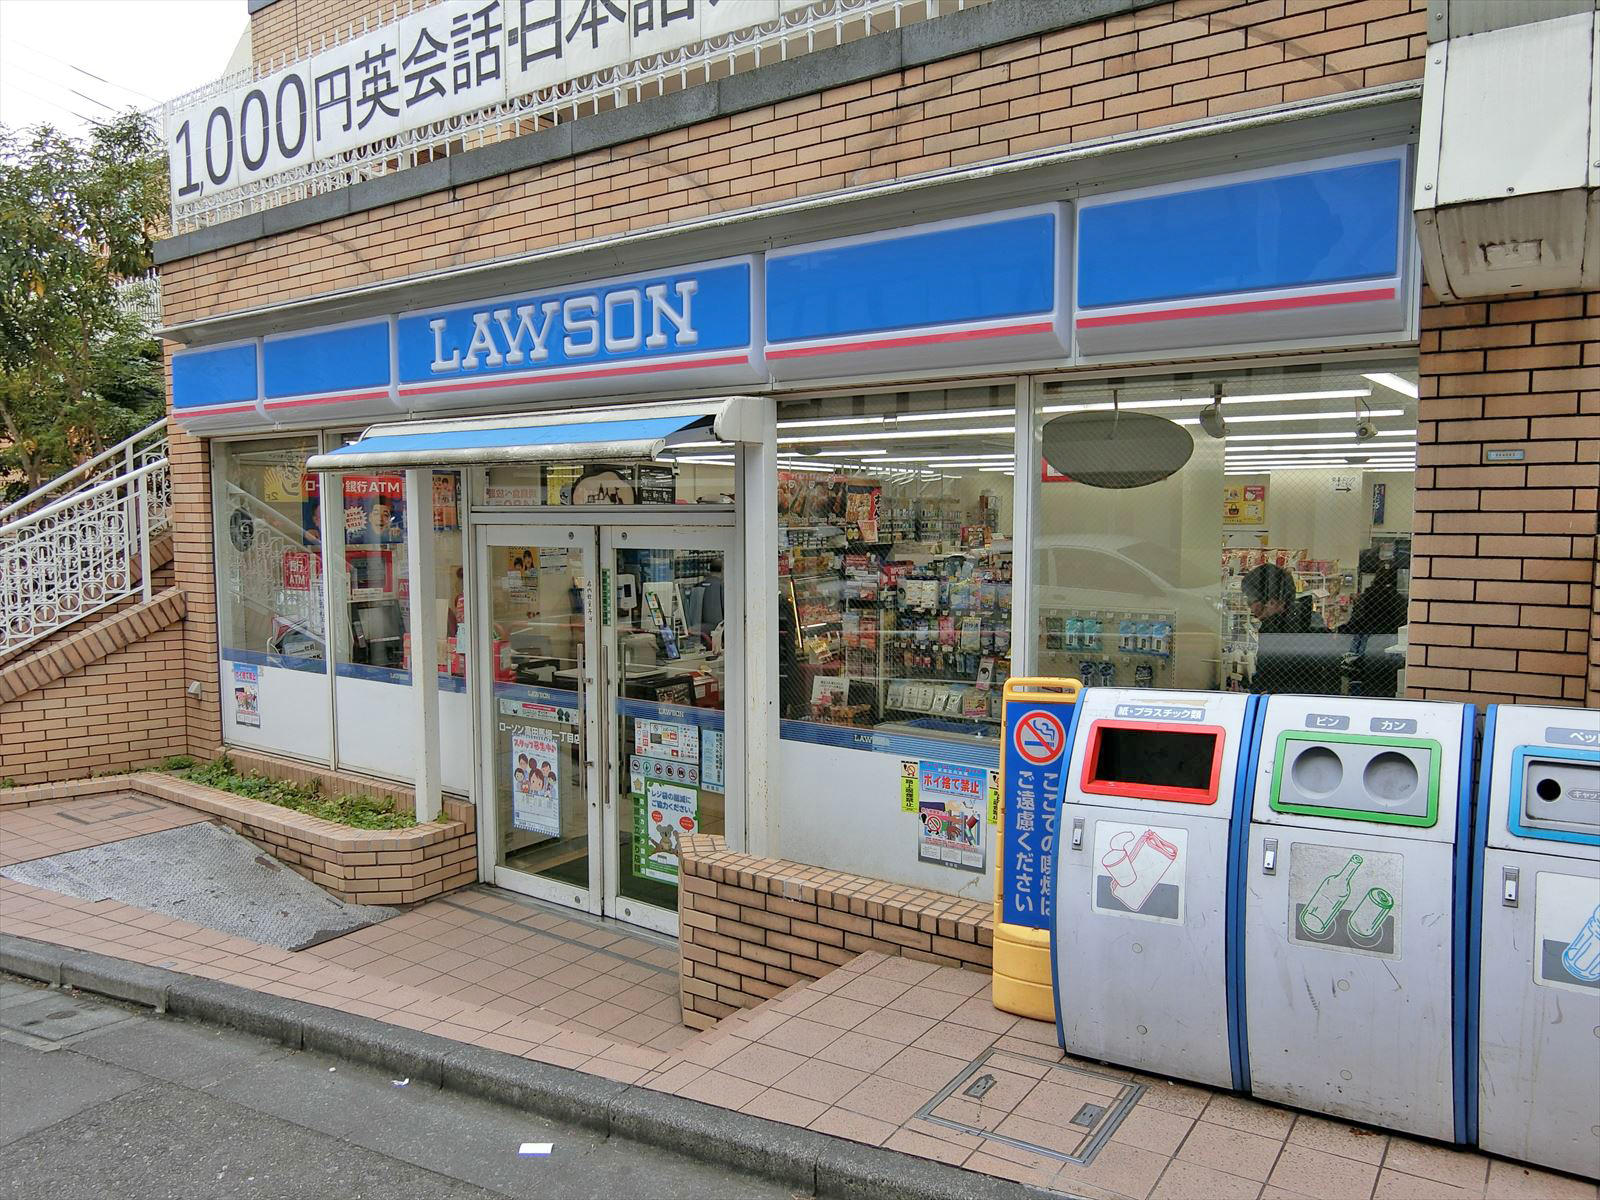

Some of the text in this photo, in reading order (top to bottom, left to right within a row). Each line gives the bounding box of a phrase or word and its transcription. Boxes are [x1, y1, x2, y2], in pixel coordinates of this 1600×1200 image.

[176, 0, 718, 197] 1,000円英会話・日本
[429, 279, 698, 373] LAWSON
[289, 574, 305, 585] ATM
[399, 582, 410, 593] AT
[1118, 706, 1203, 720] 紙・プラスチック類
[1316, 716, 1340, 727] ビン
[1380, 720, 1406, 731] カン
[923, 773, 980, 794] ポイ捨て禁止
[1573, 790, 1600, 799] キャッ
[1015, 770, 1035, 912] ご遠慮ください
